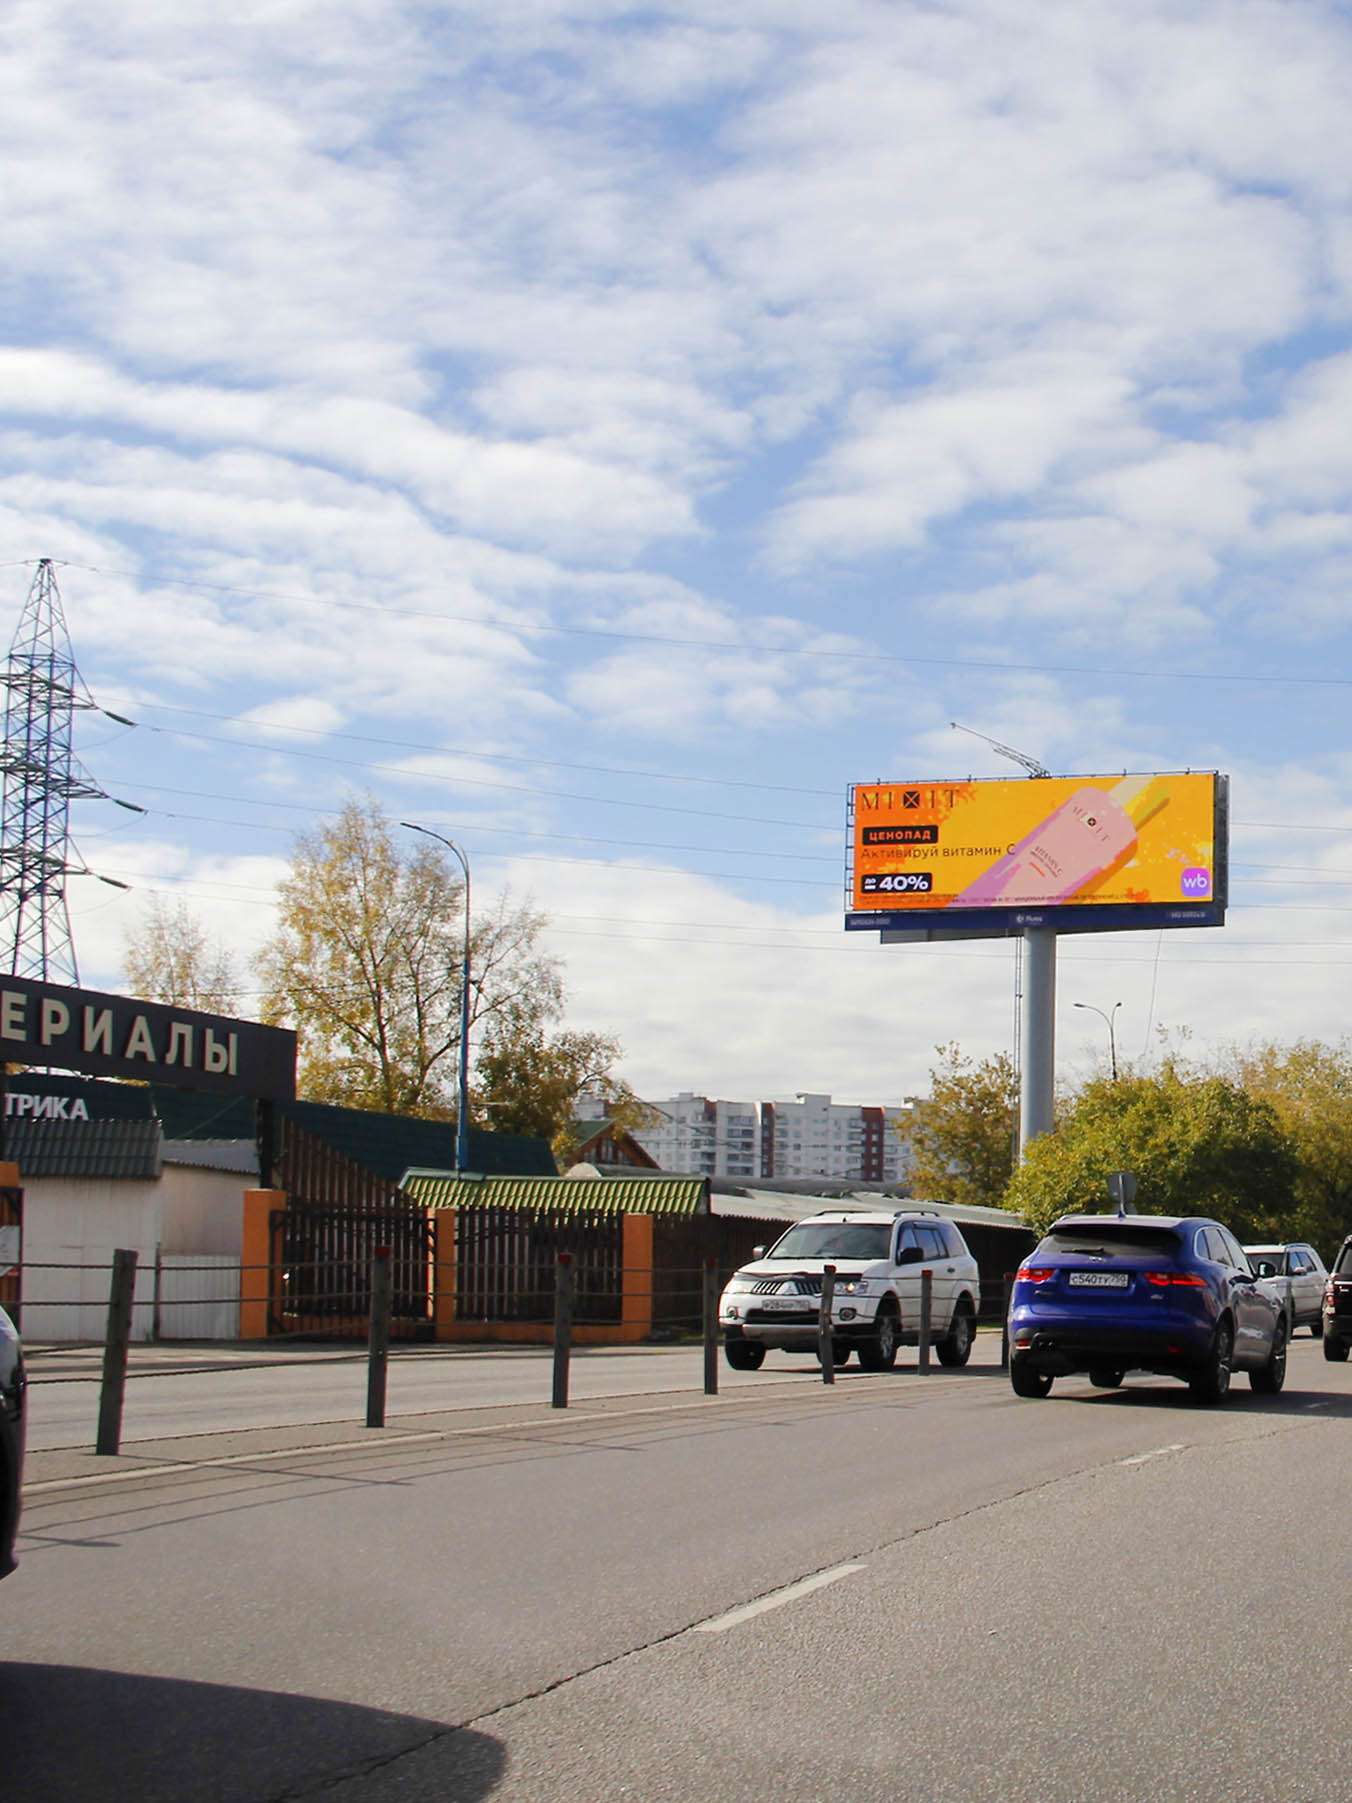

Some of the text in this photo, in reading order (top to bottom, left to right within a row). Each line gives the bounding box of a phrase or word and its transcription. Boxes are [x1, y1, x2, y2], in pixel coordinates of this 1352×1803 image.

[868, 829, 932, 842] ЦЕНОПАД
[861, 846, 938, 859] Активируй
[943, 847, 1001, 857] витамин
[878, 875, 929, 891] 40%
[1183, 873, 1208, 889] wb
[1, 990, 238, 1076] ЕРИАЛЫ
[4, 1092, 89, 1121] ТРИКА
